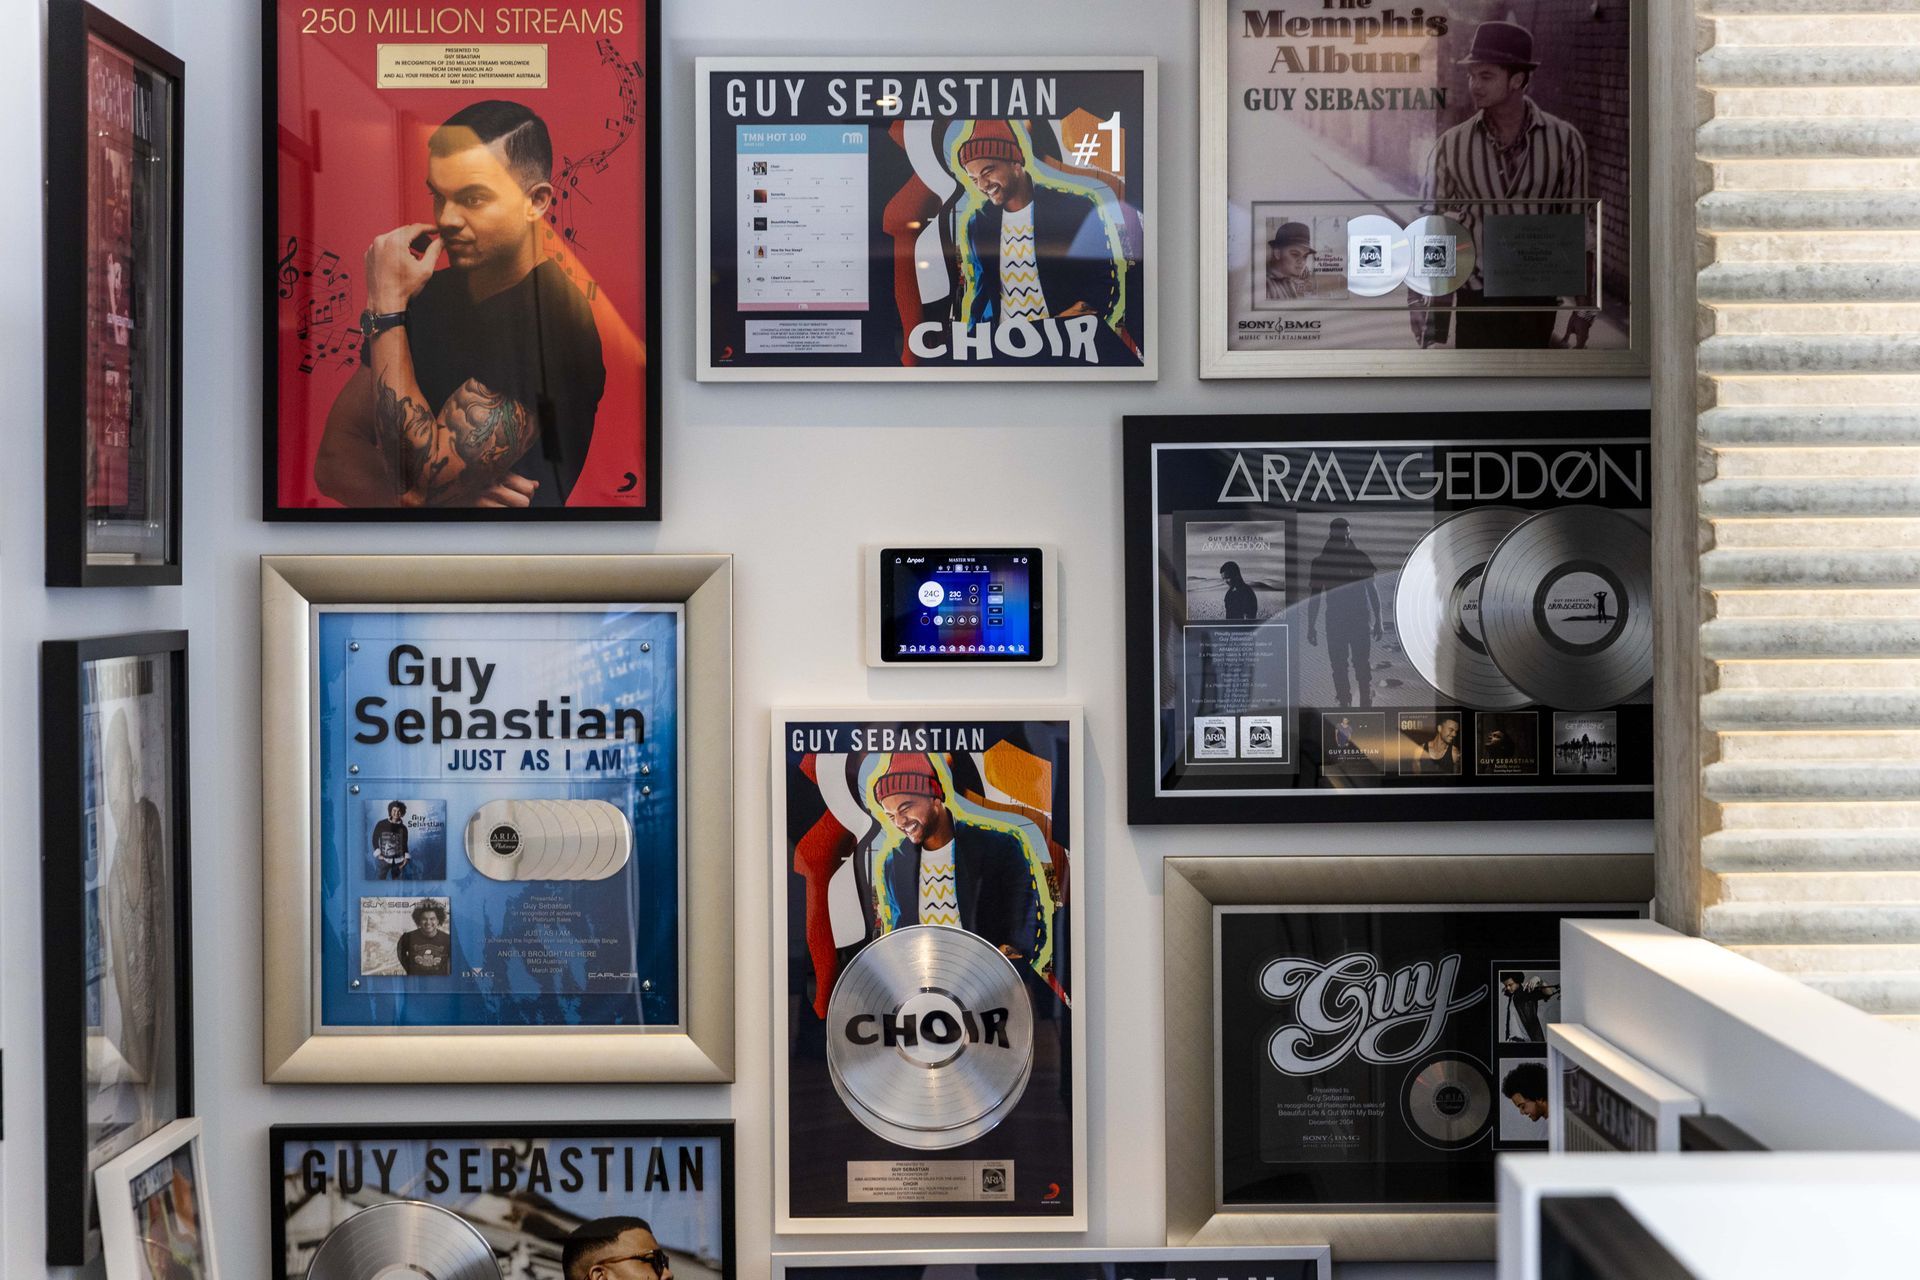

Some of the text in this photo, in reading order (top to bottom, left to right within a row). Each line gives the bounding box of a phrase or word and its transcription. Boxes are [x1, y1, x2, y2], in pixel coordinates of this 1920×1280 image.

[301, 8, 623, 34] 250 MILLION STREAMS
[1242, 7, 1449, 45] Memphis
[1268, 45, 1422, 73] Album
[726, 78, 1056, 117] GUY SEBASTIAN
[1244, 87, 1448, 111] GUY SEBASTIAN
[743, 133, 807, 142] TMN HOT 100
[1071, 111, 1121, 172] #1
[1238, 320, 1321, 329] SONY BMG
[908, 314, 1099, 364] CHOIR
[924, 590, 940, 598] 24C
[388, 644, 496, 704] Guy
[354, 695, 645, 744] Sebastian
[1401, 720, 1423, 731] GOLD
[792, 728, 985, 752] GUY SEBASTIAN
[1205, 733, 1226, 741] ARIA
[1251, 733, 1271, 741] ARIA
[448, 749, 621, 771] JUST AS I AM
[1259, 952, 1488, 1076] Guy
[845, 1007, 1010, 1049] CHOIR
[1307, 1095, 1321, 1103] Guy
[1278, 1109, 1385, 1117] Beautiful Life & Out With My Baby
[303, 1146, 703, 1194] GUY SEBASTIAN
